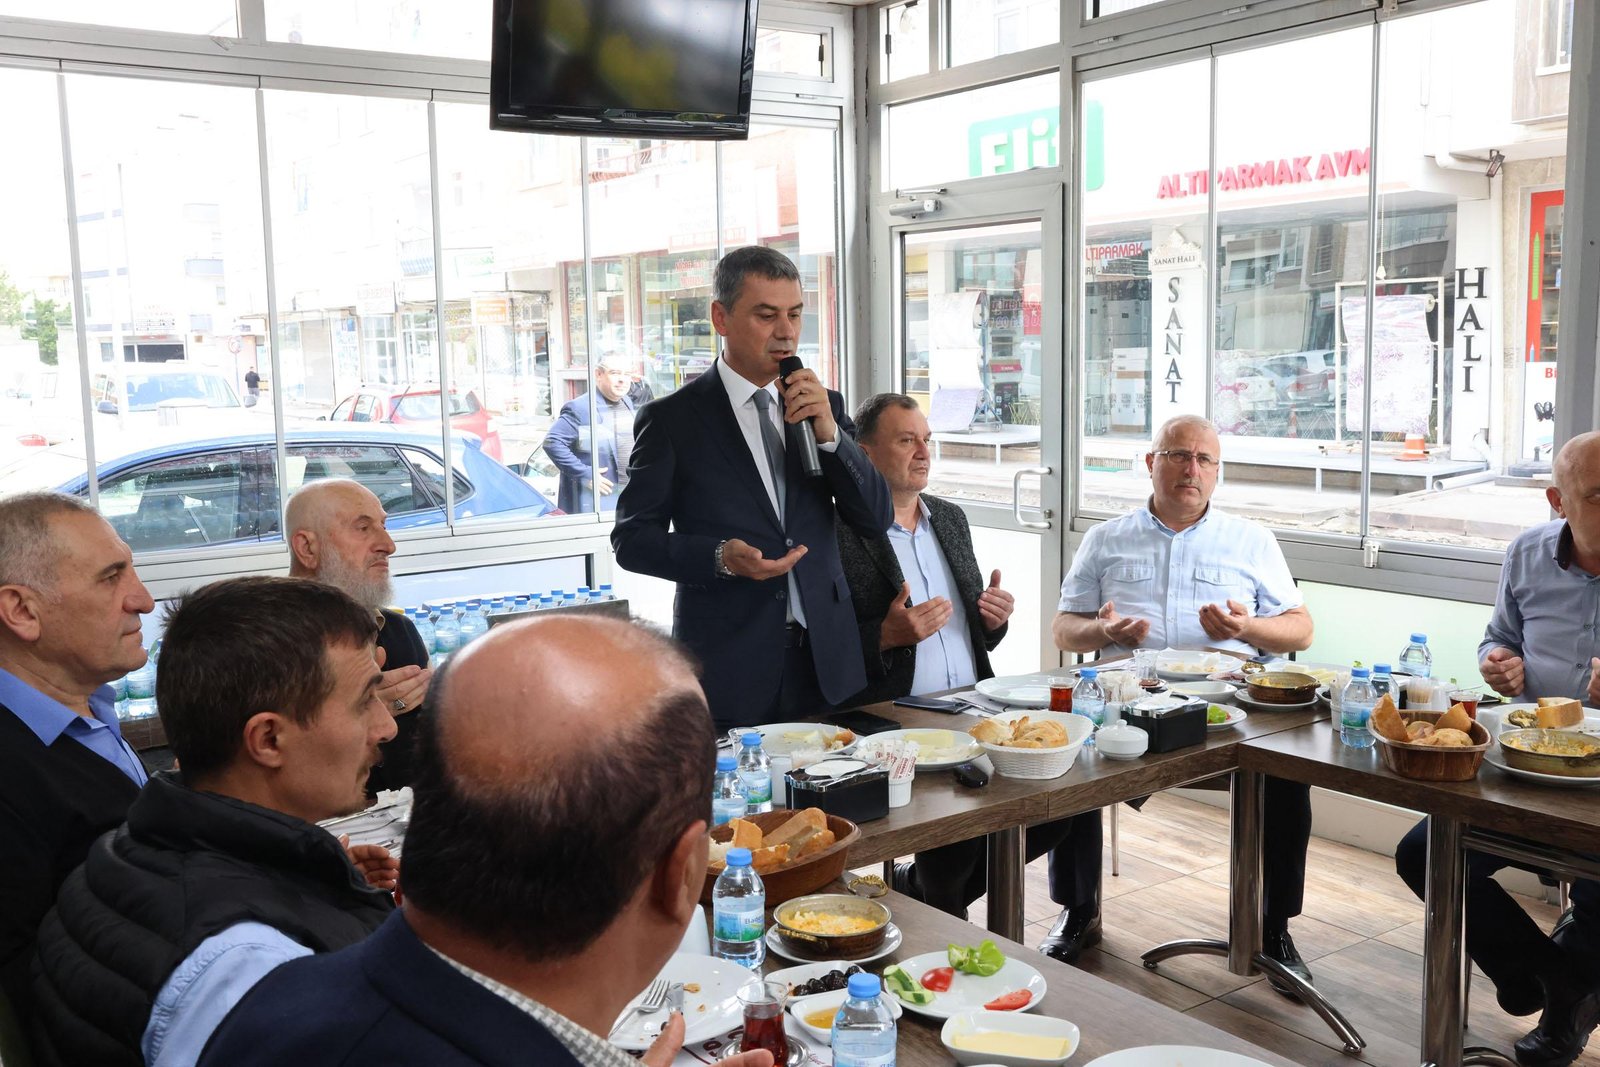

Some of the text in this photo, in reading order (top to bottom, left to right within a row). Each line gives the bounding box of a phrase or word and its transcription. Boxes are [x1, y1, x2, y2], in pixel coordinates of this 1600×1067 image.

[1314, 146, 1372, 181] AVM
[1085, 242, 1144, 261] LTIPARMAK
[1154, 257, 1176, 266] SANAT
[1164, 276, 1184, 403] SANAT
[1455, 266, 1488, 393] HALI
